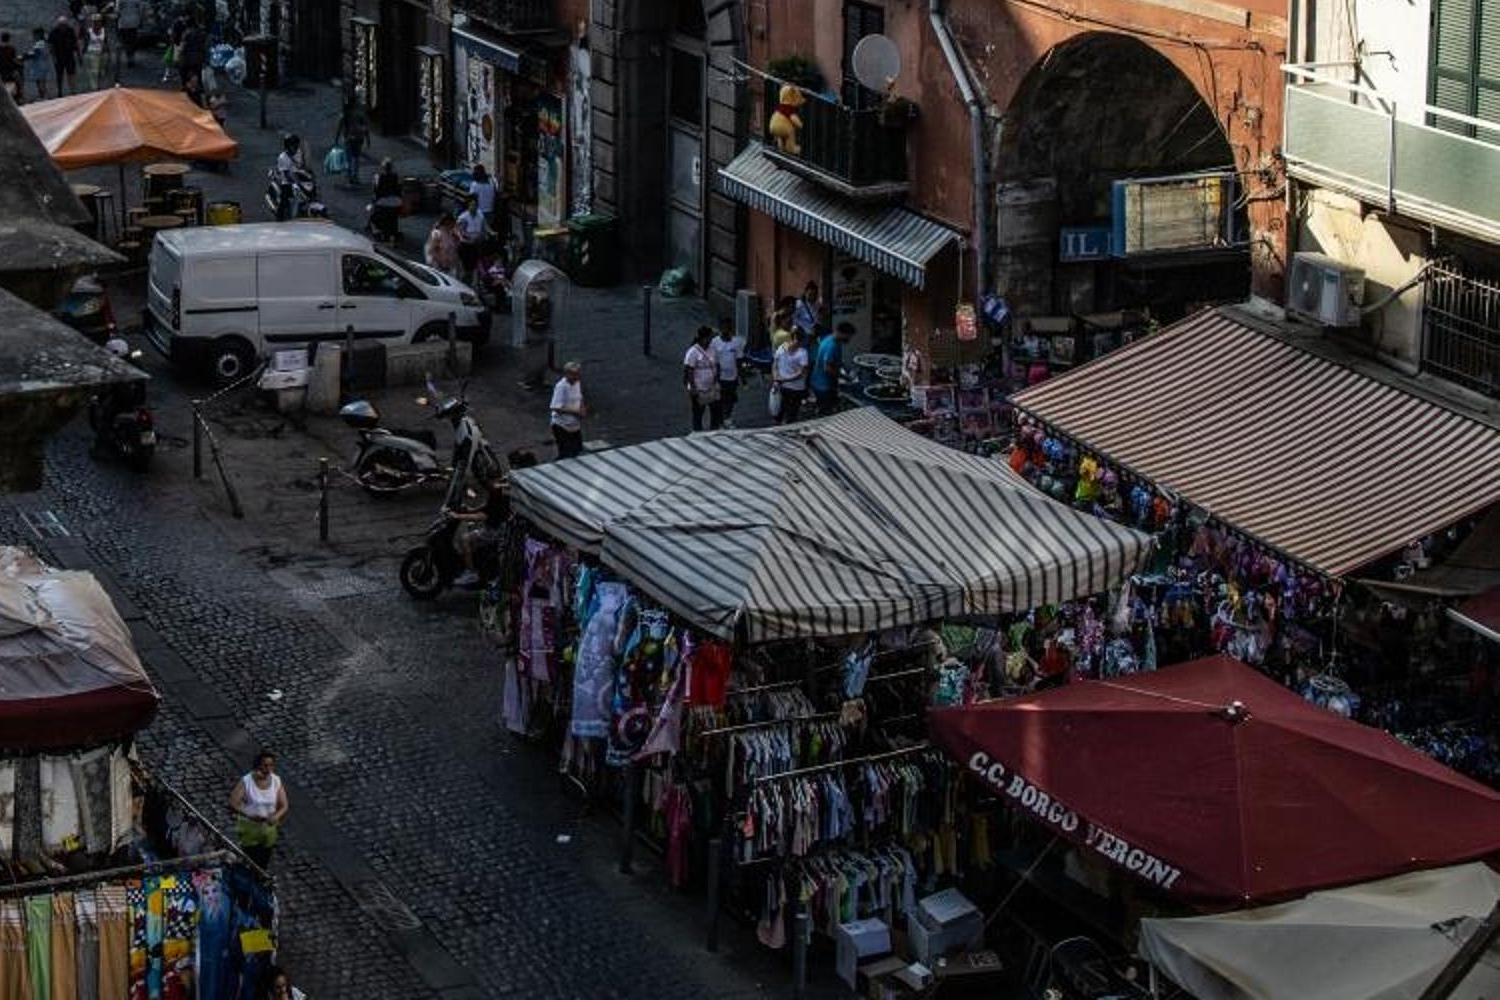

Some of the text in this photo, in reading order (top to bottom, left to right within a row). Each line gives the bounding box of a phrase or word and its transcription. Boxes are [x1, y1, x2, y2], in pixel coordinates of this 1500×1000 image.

[968, 751, 1183, 890] C.C. BORGO VERGINI
